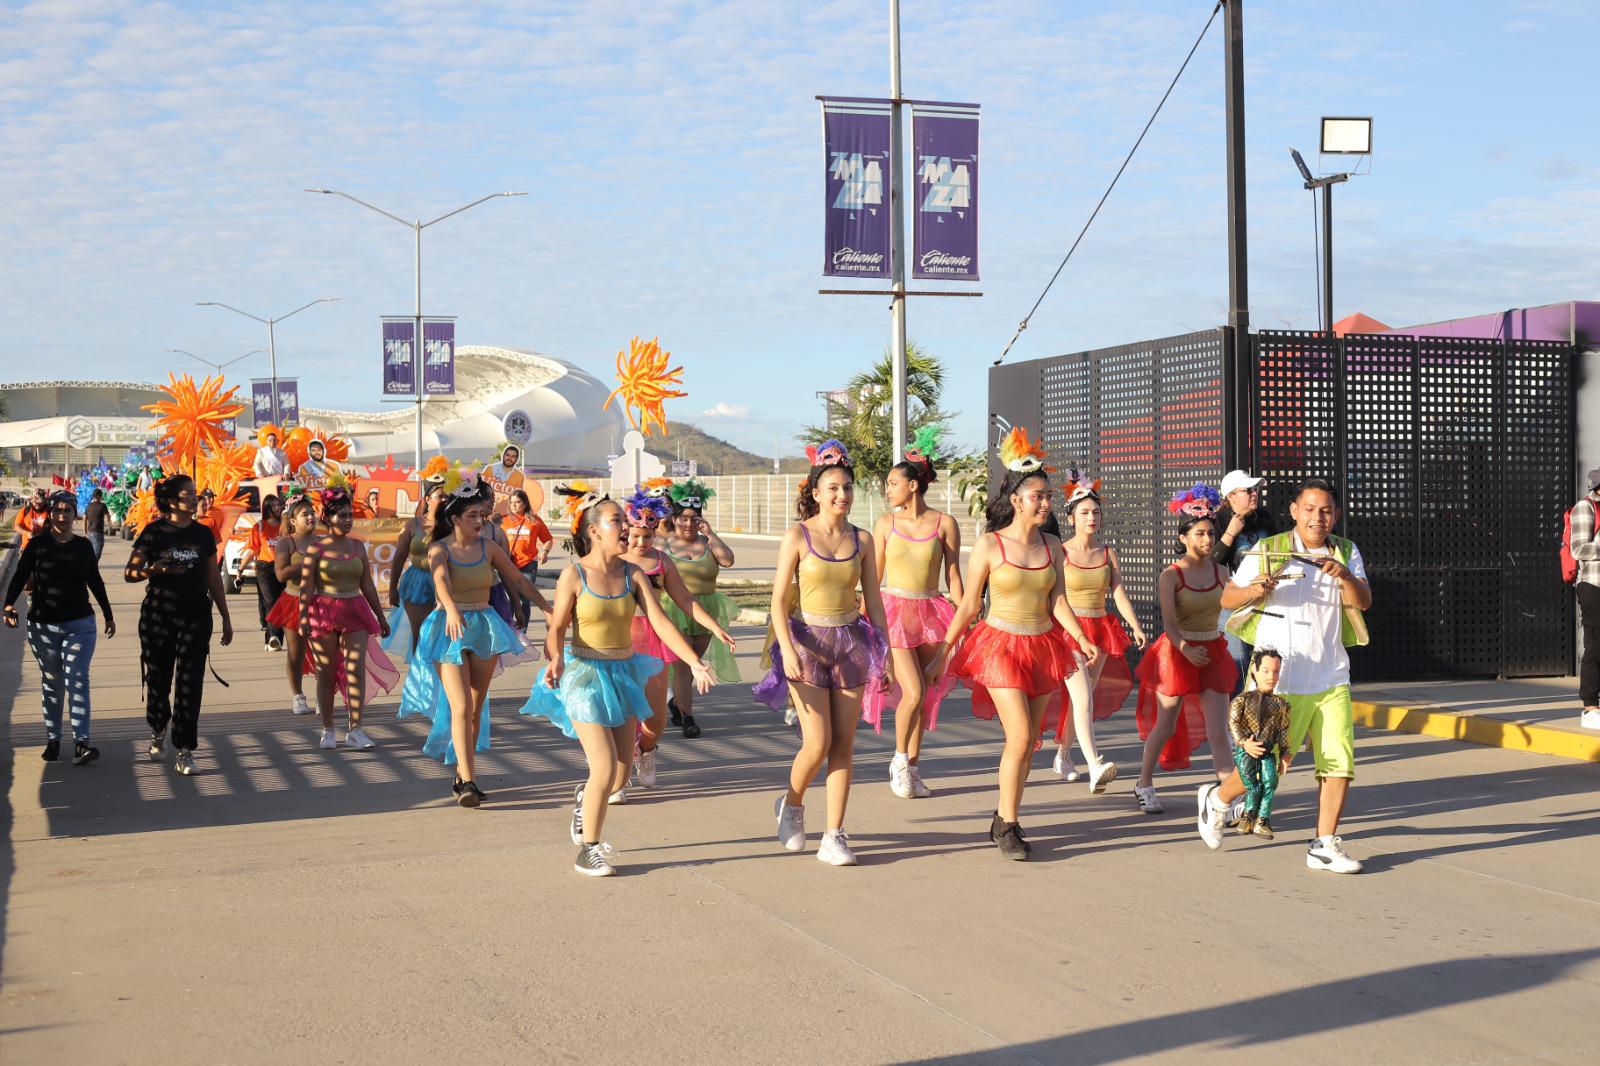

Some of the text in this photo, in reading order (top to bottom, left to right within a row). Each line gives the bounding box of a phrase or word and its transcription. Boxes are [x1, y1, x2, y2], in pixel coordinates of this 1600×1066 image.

[832, 247, 884, 264] Caliente
[920, 249, 971, 267] Caliente
[835, 263, 881, 271] caliente.mx
[923, 266, 969, 274] caliente.mx
